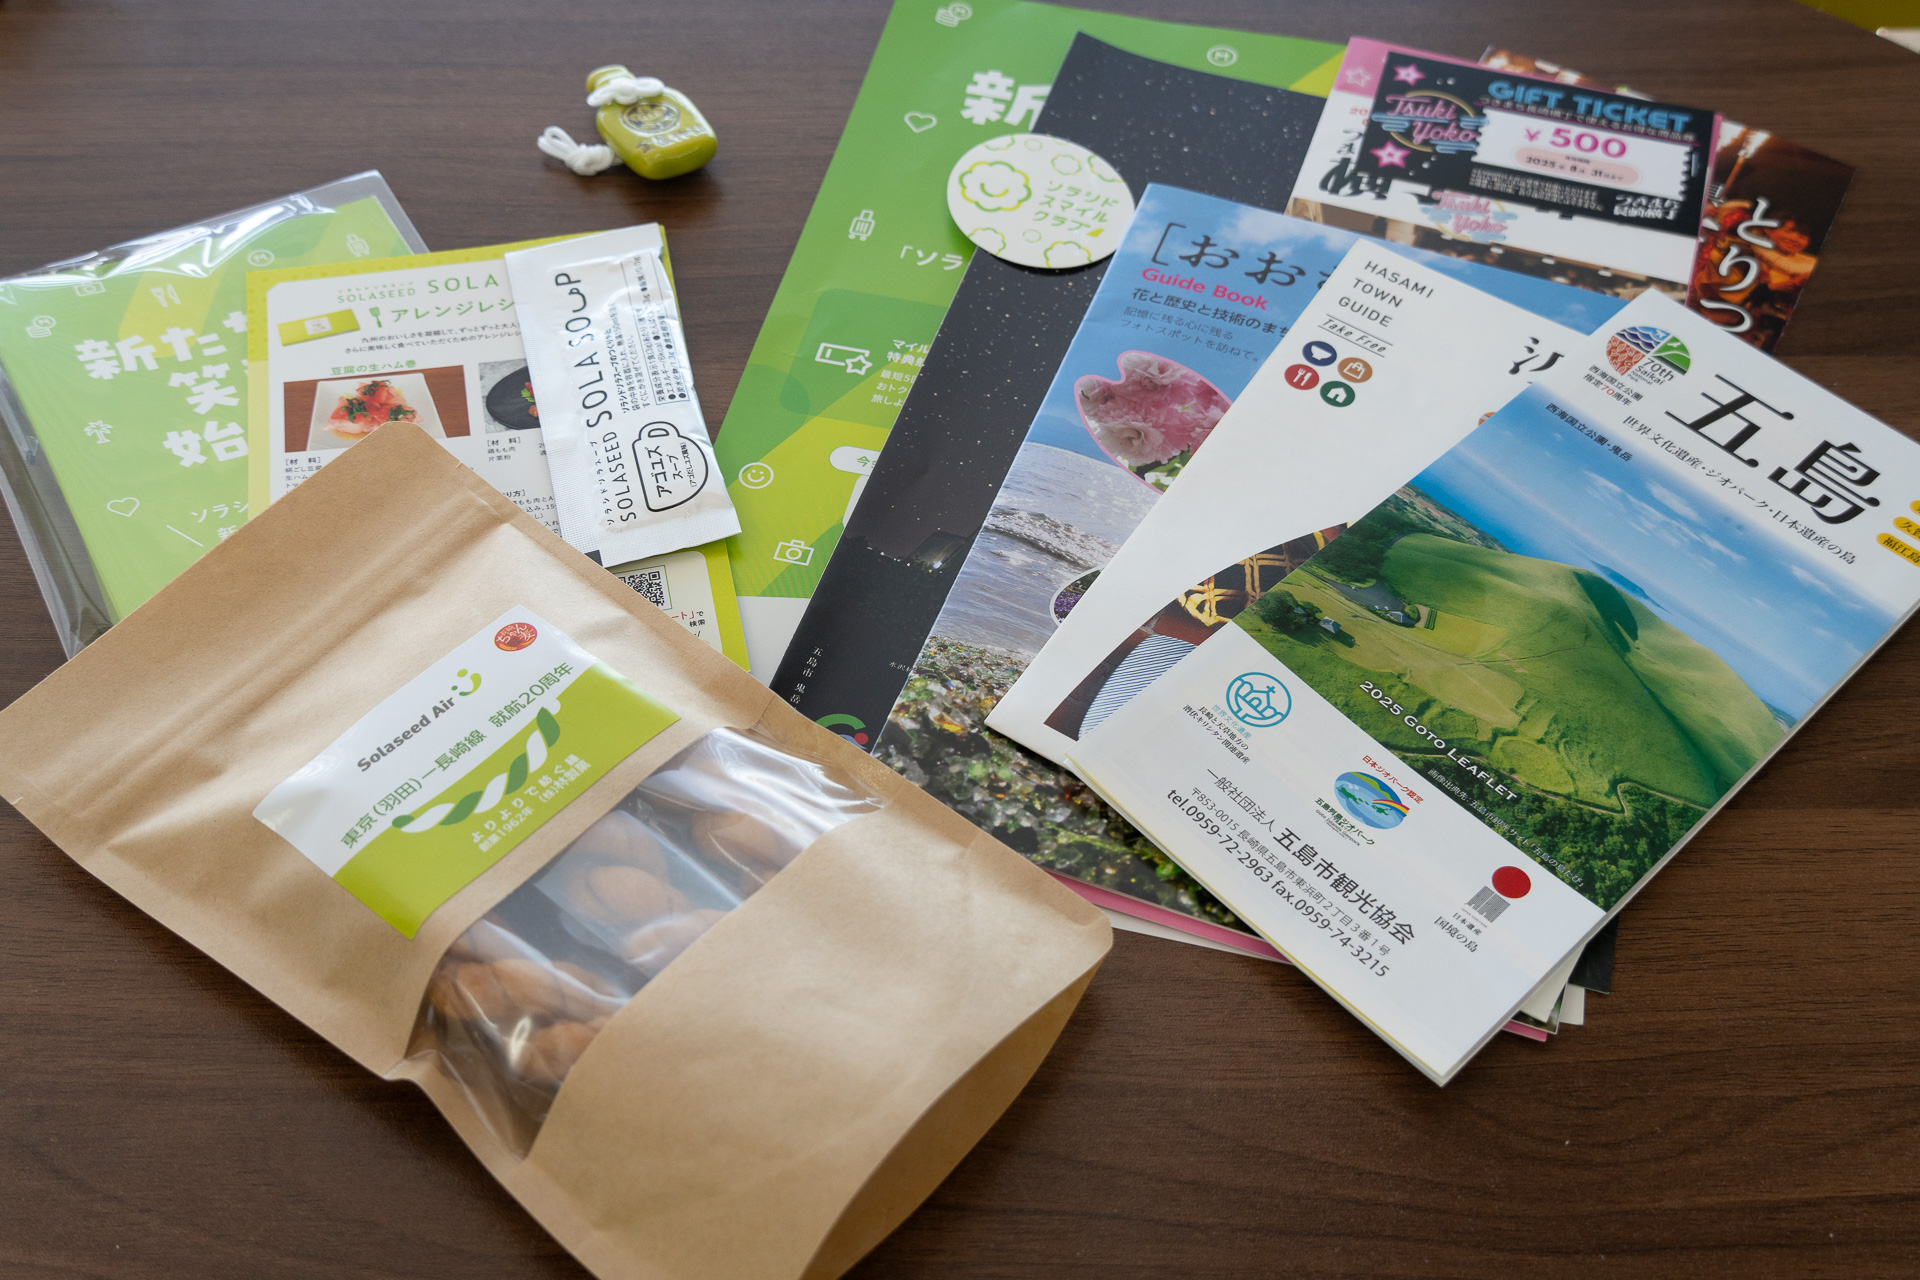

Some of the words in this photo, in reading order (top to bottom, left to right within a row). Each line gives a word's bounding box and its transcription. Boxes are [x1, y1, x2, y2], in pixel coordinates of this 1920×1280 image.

[1385, 93, 1457, 119] Tsuki
[1488, 79, 1565, 109] GIFT
[1572, 94, 1692, 133] TICKET
[1412, 120, 1480, 145] Yoko
[1038, 195, 1109, 224] スマイル
[1045, 180, 1119, 209] ソラシド
[1031, 210, 1092, 232] クラブ
[337, 286, 417, 304] SOLASEED
[427, 273, 500, 295] SOLA
[1141, 267, 1206, 294] Guide
[1212, 284, 1270, 311] Book
[1352, 277, 1403, 309] TOWN
[1364, 259, 1435, 299] HASAMI
[1122, 305, 1234, 341] 記憶に残る心に残る
[1131, 287, 1291, 338] 花と歴史と技術のまち
[1338, 296, 1394, 328] GUIDE
[1121, 318, 1260, 363] フォトスポットを訪ねて。
[1322, 317, 1354, 338] Take
[1356, 334, 1387, 354] Free
[330, 359, 418, 376] 豆腐の生ハム巻
[880, 369, 917, 384] 最短5
[1588, 364, 1644, 402] 西海国立公園
[1635, 365, 1666, 386] Saikai
[1642, 357, 1675, 382] 70th
[574, 351, 613, 428] SOLA
[876, 382, 908, 394] おトク
[1583, 373, 1633, 407] 指定70周年
[1545, 402, 1633, 463] 西海国立公園・鬼岳
[1664, 373, 1881, 525] 五島
[602, 431, 637, 522] SOLASEED
[644, 445, 673, 498] アゴユズ
[666, 454, 684, 480] スープ
[1623, 414, 1857, 566] 世界文化遺産・ジオパーク・日本遺産の島
[802, 646, 823, 678] 五島市
[488, 661, 575, 729] 就航20周年
[1359, 680, 1405, 717] 2025
[357, 713, 432, 773] Solaseed
[430, 696, 456, 720] Air
[1183, 703, 1251, 765] 潜伏キリシタン関連遺産
[1197, 705, 1249, 751] 長崎と天草地方の
[1211, 703, 1252, 740] 世界文化遺産
[1361, 754, 1424, 805] 日本ジオパーク認定
[477, 805, 535, 853] 創業1962年
[538, 758, 592, 804] (株)林製菓
[1191, 786, 1240, 832] 〒853-0015
[1314, 796, 1376, 847] 五島列島ジオパーク
[1206, 768, 1276, 834] 一般社団法人
[1273, 827, 1416, 946] 五島市観光協会
[1166, 788, 1275, 884] tel.0959-72-2963
[1270, 879, 1391, 979] fax.0959-74-3215
[1433, 915, 1480, 954] 国境の島
[1452, 911, 1482, 936] 日本遺産
